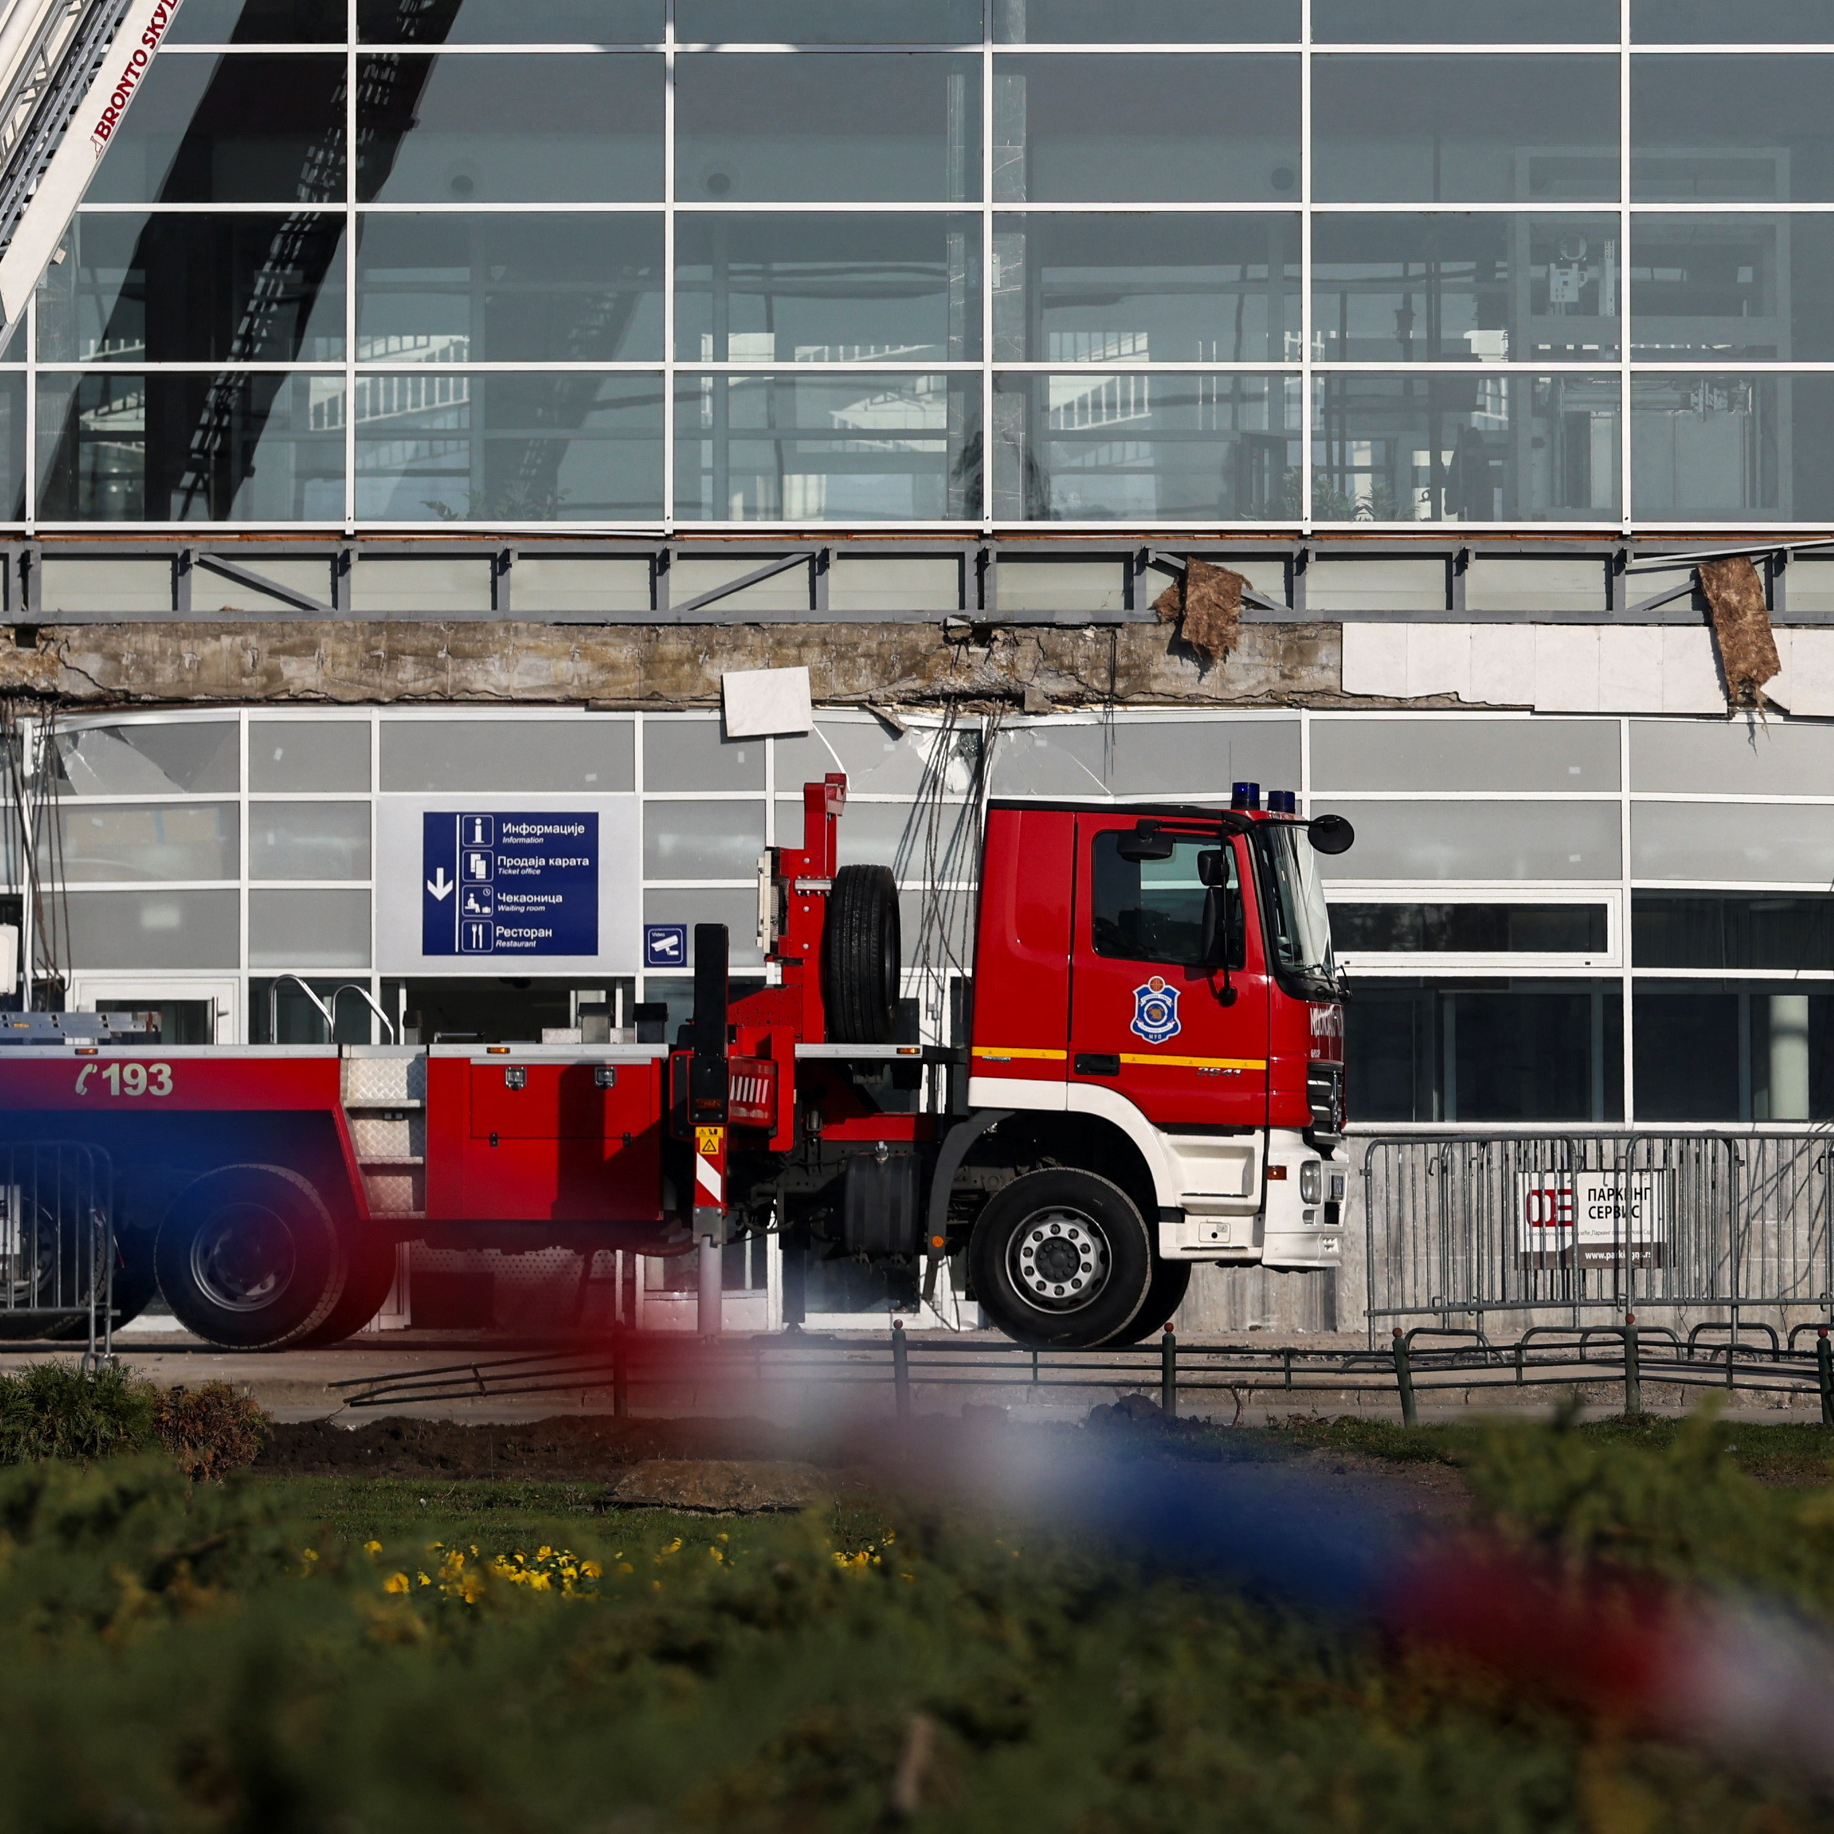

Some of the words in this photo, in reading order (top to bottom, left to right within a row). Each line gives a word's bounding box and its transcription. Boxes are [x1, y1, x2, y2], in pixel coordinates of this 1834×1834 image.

[94, 49, 148, 141] BRONTO
[502, 822, 585, 837] Информације
[502, 836, 544, 844] Information
[497, 855, 546, 868] Продаја
[548, 857, 590, 868] карата
[497, 892, 563, 904] Чекаоница
[497, 905, 525, 913] Waiting
[496, 926, 552, 940] Ресторан
[496, 939, 536, 947] Restaurant
[101, 1062, 174, 1096] 193
